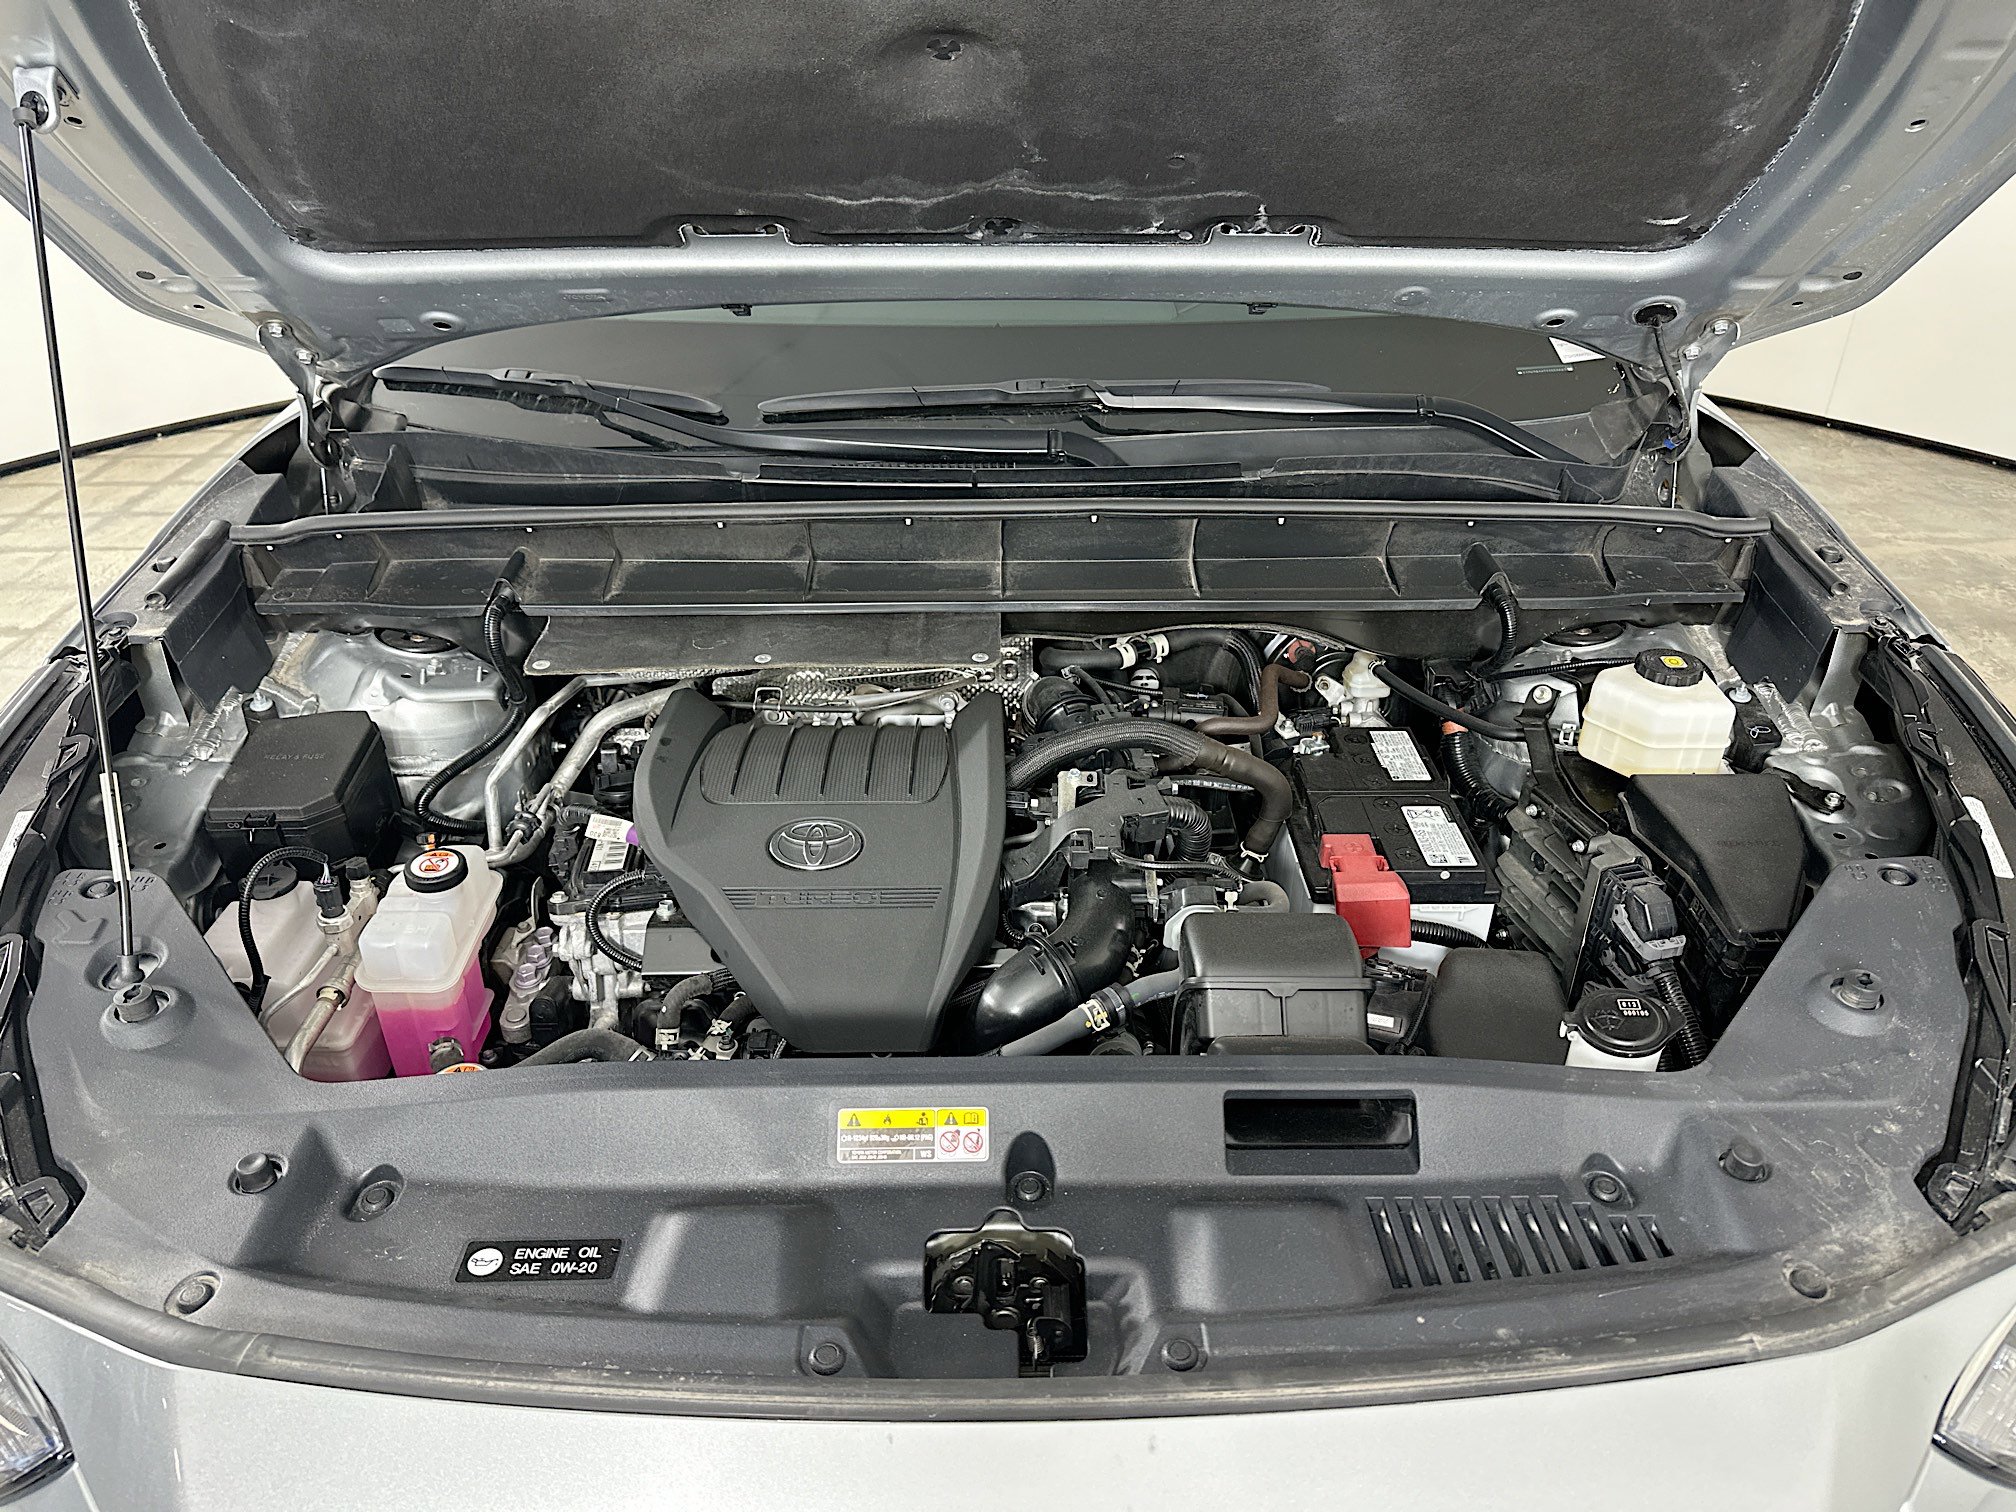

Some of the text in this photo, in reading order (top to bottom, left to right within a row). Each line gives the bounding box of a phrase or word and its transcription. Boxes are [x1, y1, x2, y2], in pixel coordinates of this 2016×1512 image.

[514, 1246, 602, 1260] ENGINE OIL
[509, 1261, 597, 1275] SAE 0W-20
